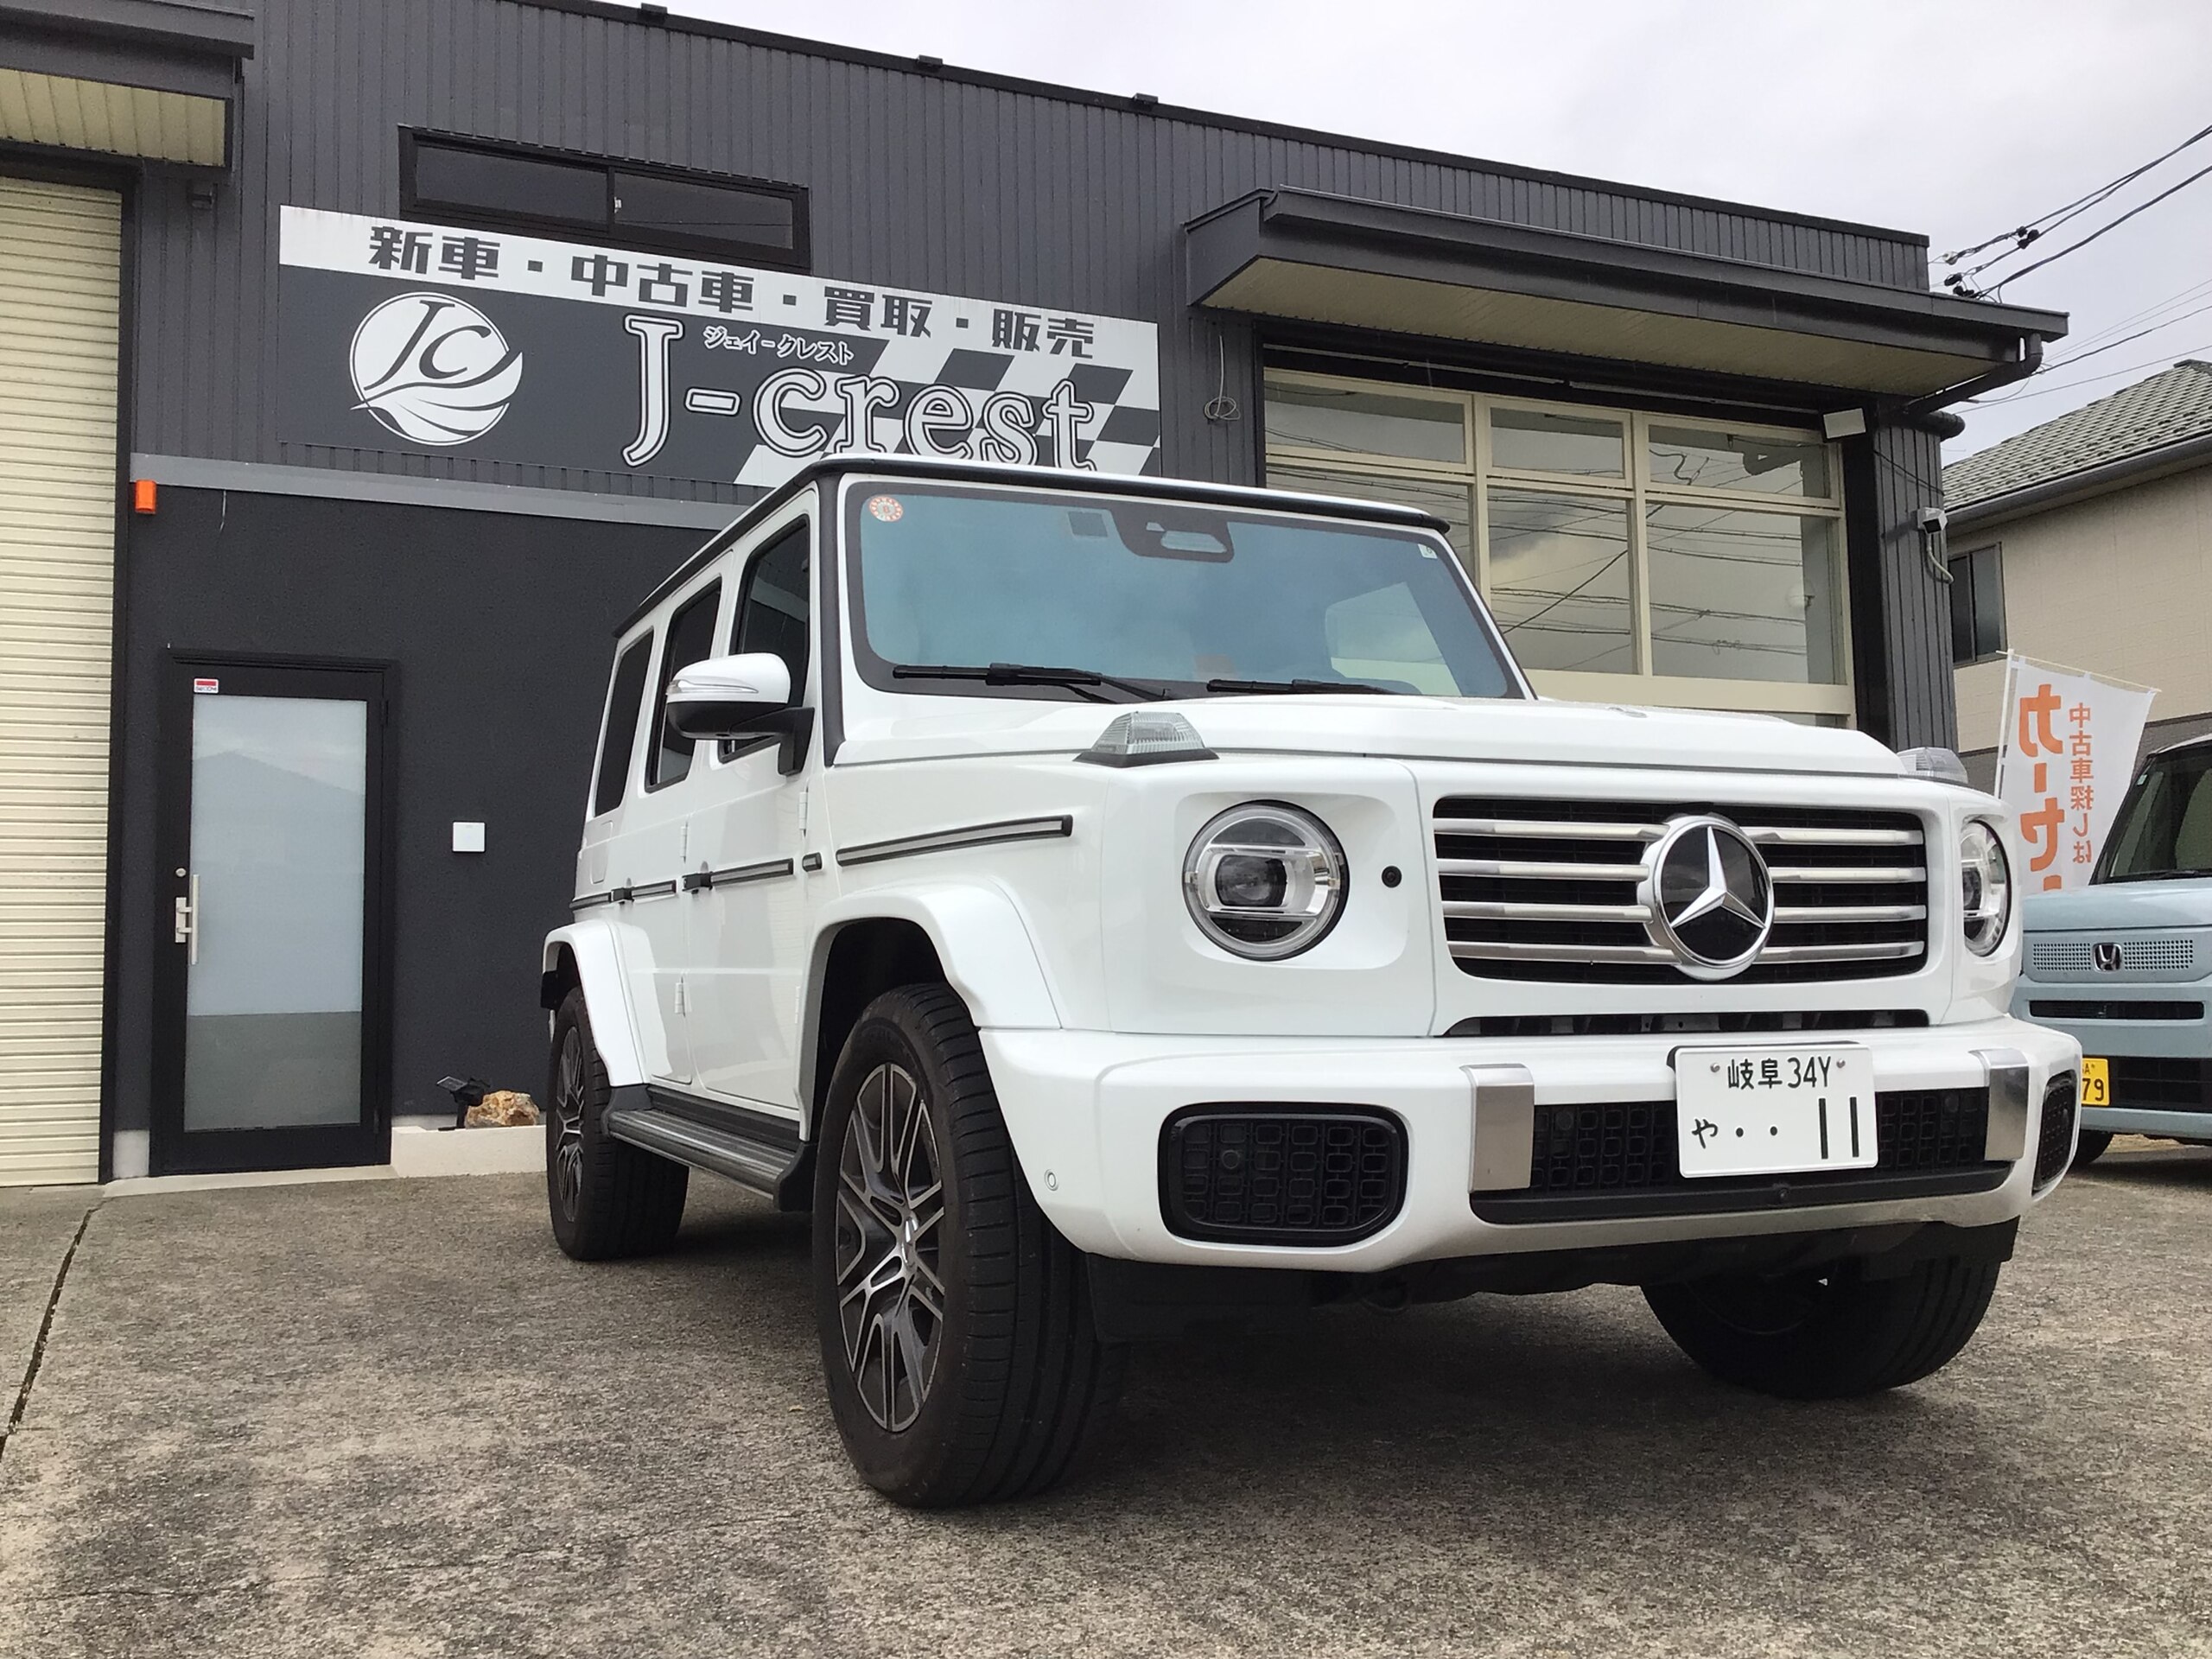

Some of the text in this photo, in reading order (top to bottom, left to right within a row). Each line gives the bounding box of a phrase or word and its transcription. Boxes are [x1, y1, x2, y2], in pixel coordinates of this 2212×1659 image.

[621, 314, 1096, 472] J-crest
[702, 325, 855, 366] ジェイークレスト
